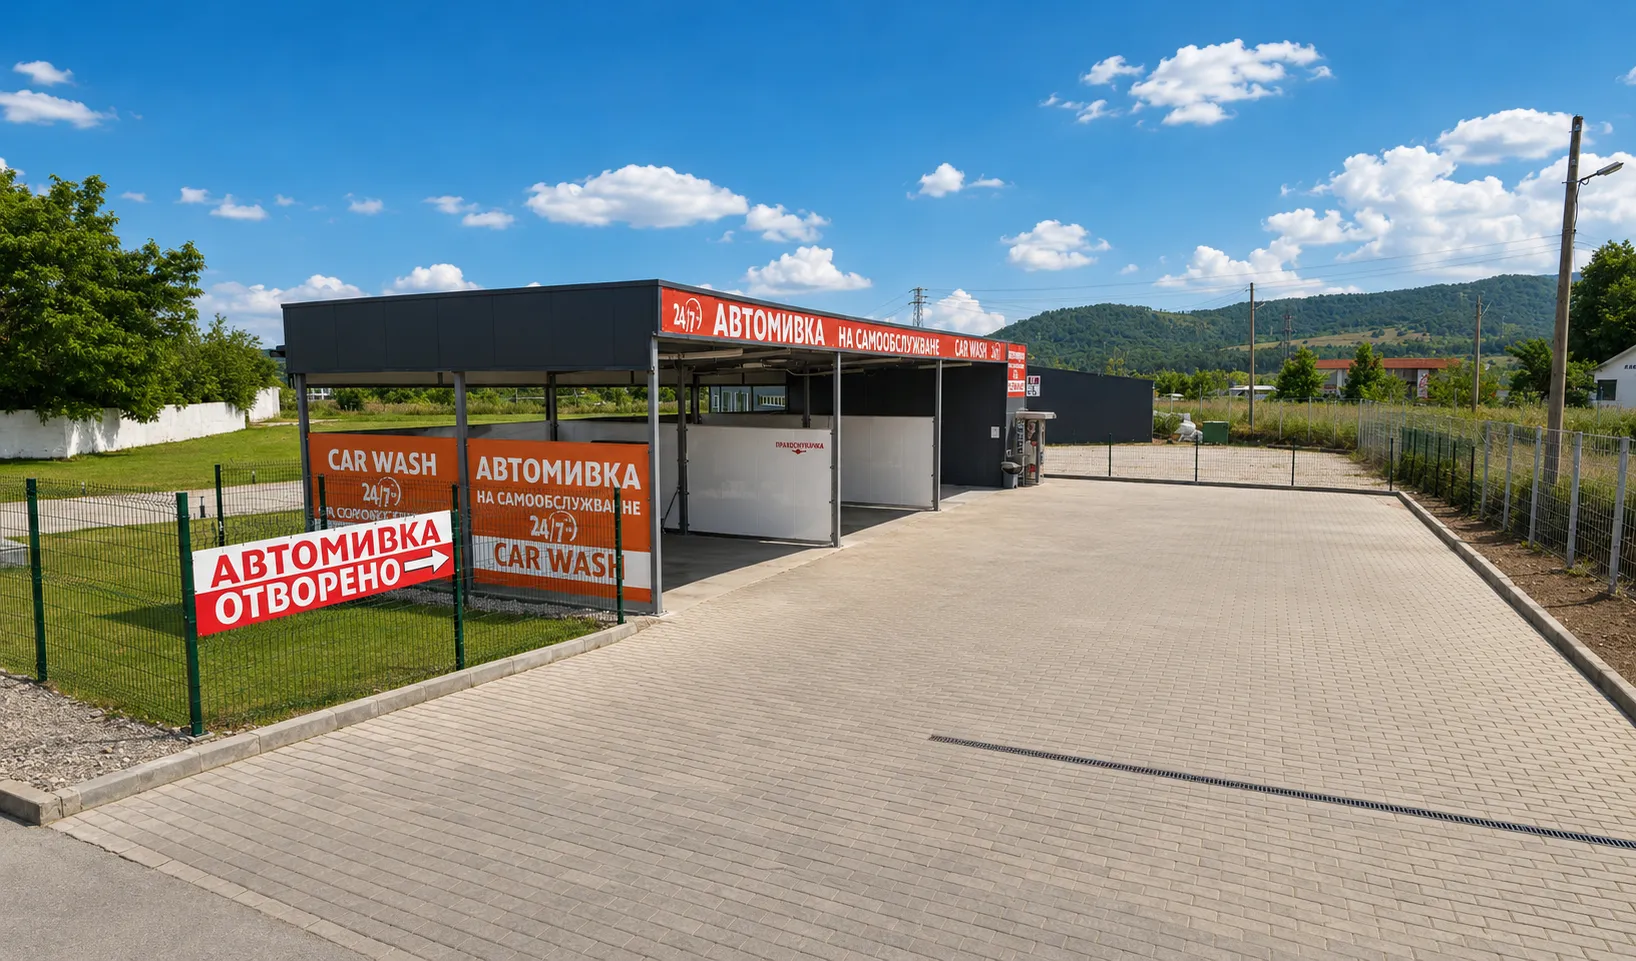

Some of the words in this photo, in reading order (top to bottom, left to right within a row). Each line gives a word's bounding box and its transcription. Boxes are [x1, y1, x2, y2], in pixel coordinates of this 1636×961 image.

[713, 302, 826, 346] АВТОМИВКА
[838, 326, 854, 348] НА
[855, 328, 940, 356] САМООБСЛУЖВАНЕ
[954, 339, 969, 358] CAR
[969, 340, 988, 359] WASH
[328, 448, 368, 473] CAR
[371, 450, 437, 476] WASH
[475, 455, 642, 490] АВТОМИВКА
[476, 490, 495, 505] НА
[210, 519, 441, 588] АВТОМИВКА
[494, 542, 541, 571] CAR
[546, 548, 625, 580] WASH
[215, 558, 401, 625] ОТВОРЕНО
